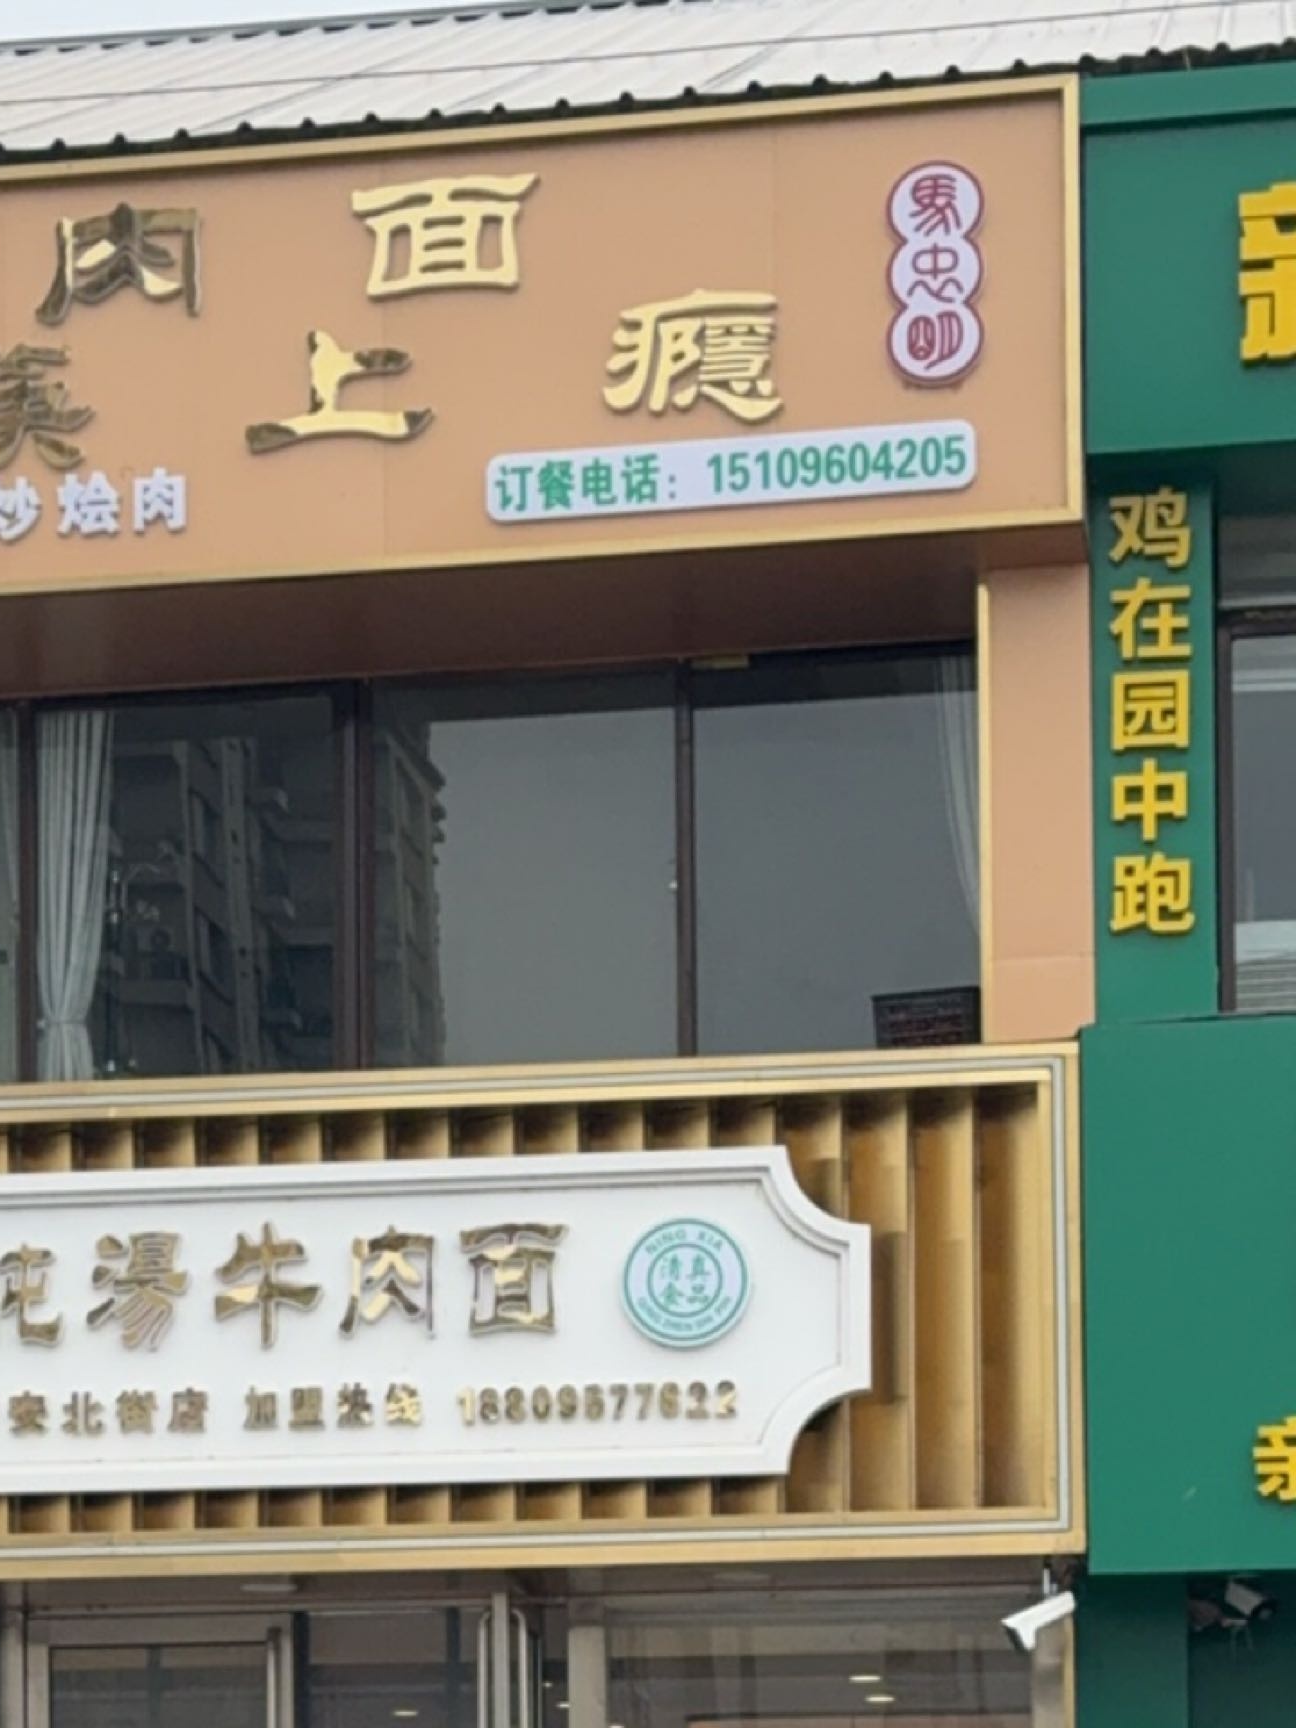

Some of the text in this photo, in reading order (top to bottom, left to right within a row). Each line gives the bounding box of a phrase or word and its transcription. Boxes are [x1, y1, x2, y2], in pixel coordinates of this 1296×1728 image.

[704, 433, 968, 496] 15109604205
[1109, 484, 1195, 937] 鸡在园中跑
[242, 1382, 422, 1433] 加盟热线
